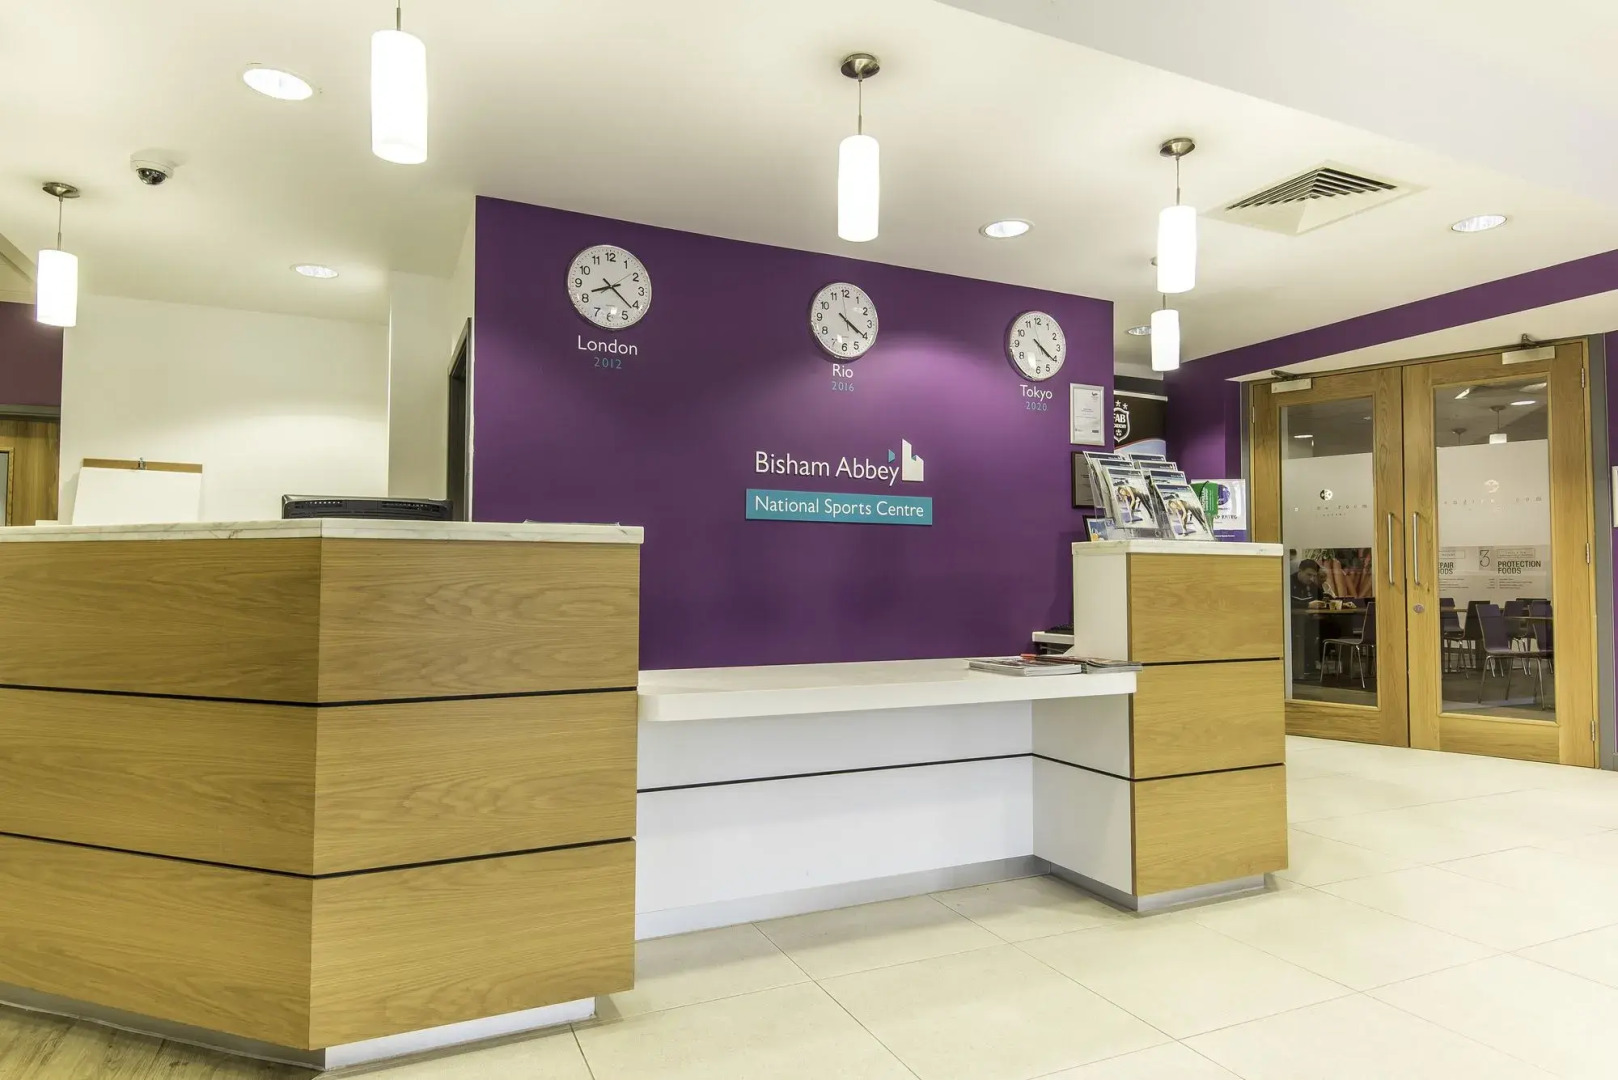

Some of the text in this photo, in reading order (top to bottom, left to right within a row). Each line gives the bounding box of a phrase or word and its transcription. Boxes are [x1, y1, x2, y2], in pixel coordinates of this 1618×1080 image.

[592, 256, 600, 265] 11
[605, 253, 616, 262] 12
[580, 266, 590, 275] 10
[632, 272, 639, 282] 2
[575, 278, 582, 287] 9
[638, 287, 644, 296] 3
[830, 292, 838, 300] 11
[841, 290, 850, 298] 12
[582, 294, 589, 303] 8
[632, 300, 639, 309] 4
[821, 302, 830, 310] 10
[594, 307, 600, 317] 7
[622, 310, 628, 320] 5
[862, 307, 868, 316] 2
[816, 313, 822, 321] 9
[867, 320, 872, 328] 3
[1025, 320, 1031, 328] 11
[1034, 318, 1042, 326] 12
[822, 326, 828, 335] 8
[1052, 332, 1057, 340] 2
[578, 335, 638, 356] London
[842, 343, 848, 352] 6
[854, 341, 860, 350] 5
[594, 357, 622, 369] 2012
[832, 364, 854, 378] Rio
[1036, 366, 1041, 374] 6
[1046, 364, 1050, 372] 5
[832, 381, 854, 392] 2016
[1020, 384, 1052, 402] Tokyo
[1026, 402, 1048, 411] 2020
[756, 451, 900, 486] Bisham Abbey
[755, 496, 924, 518] National Sports Centre
[1480, 550, 1490, 568] 3
[1498, 560, 1542, 568] PROTECTION
